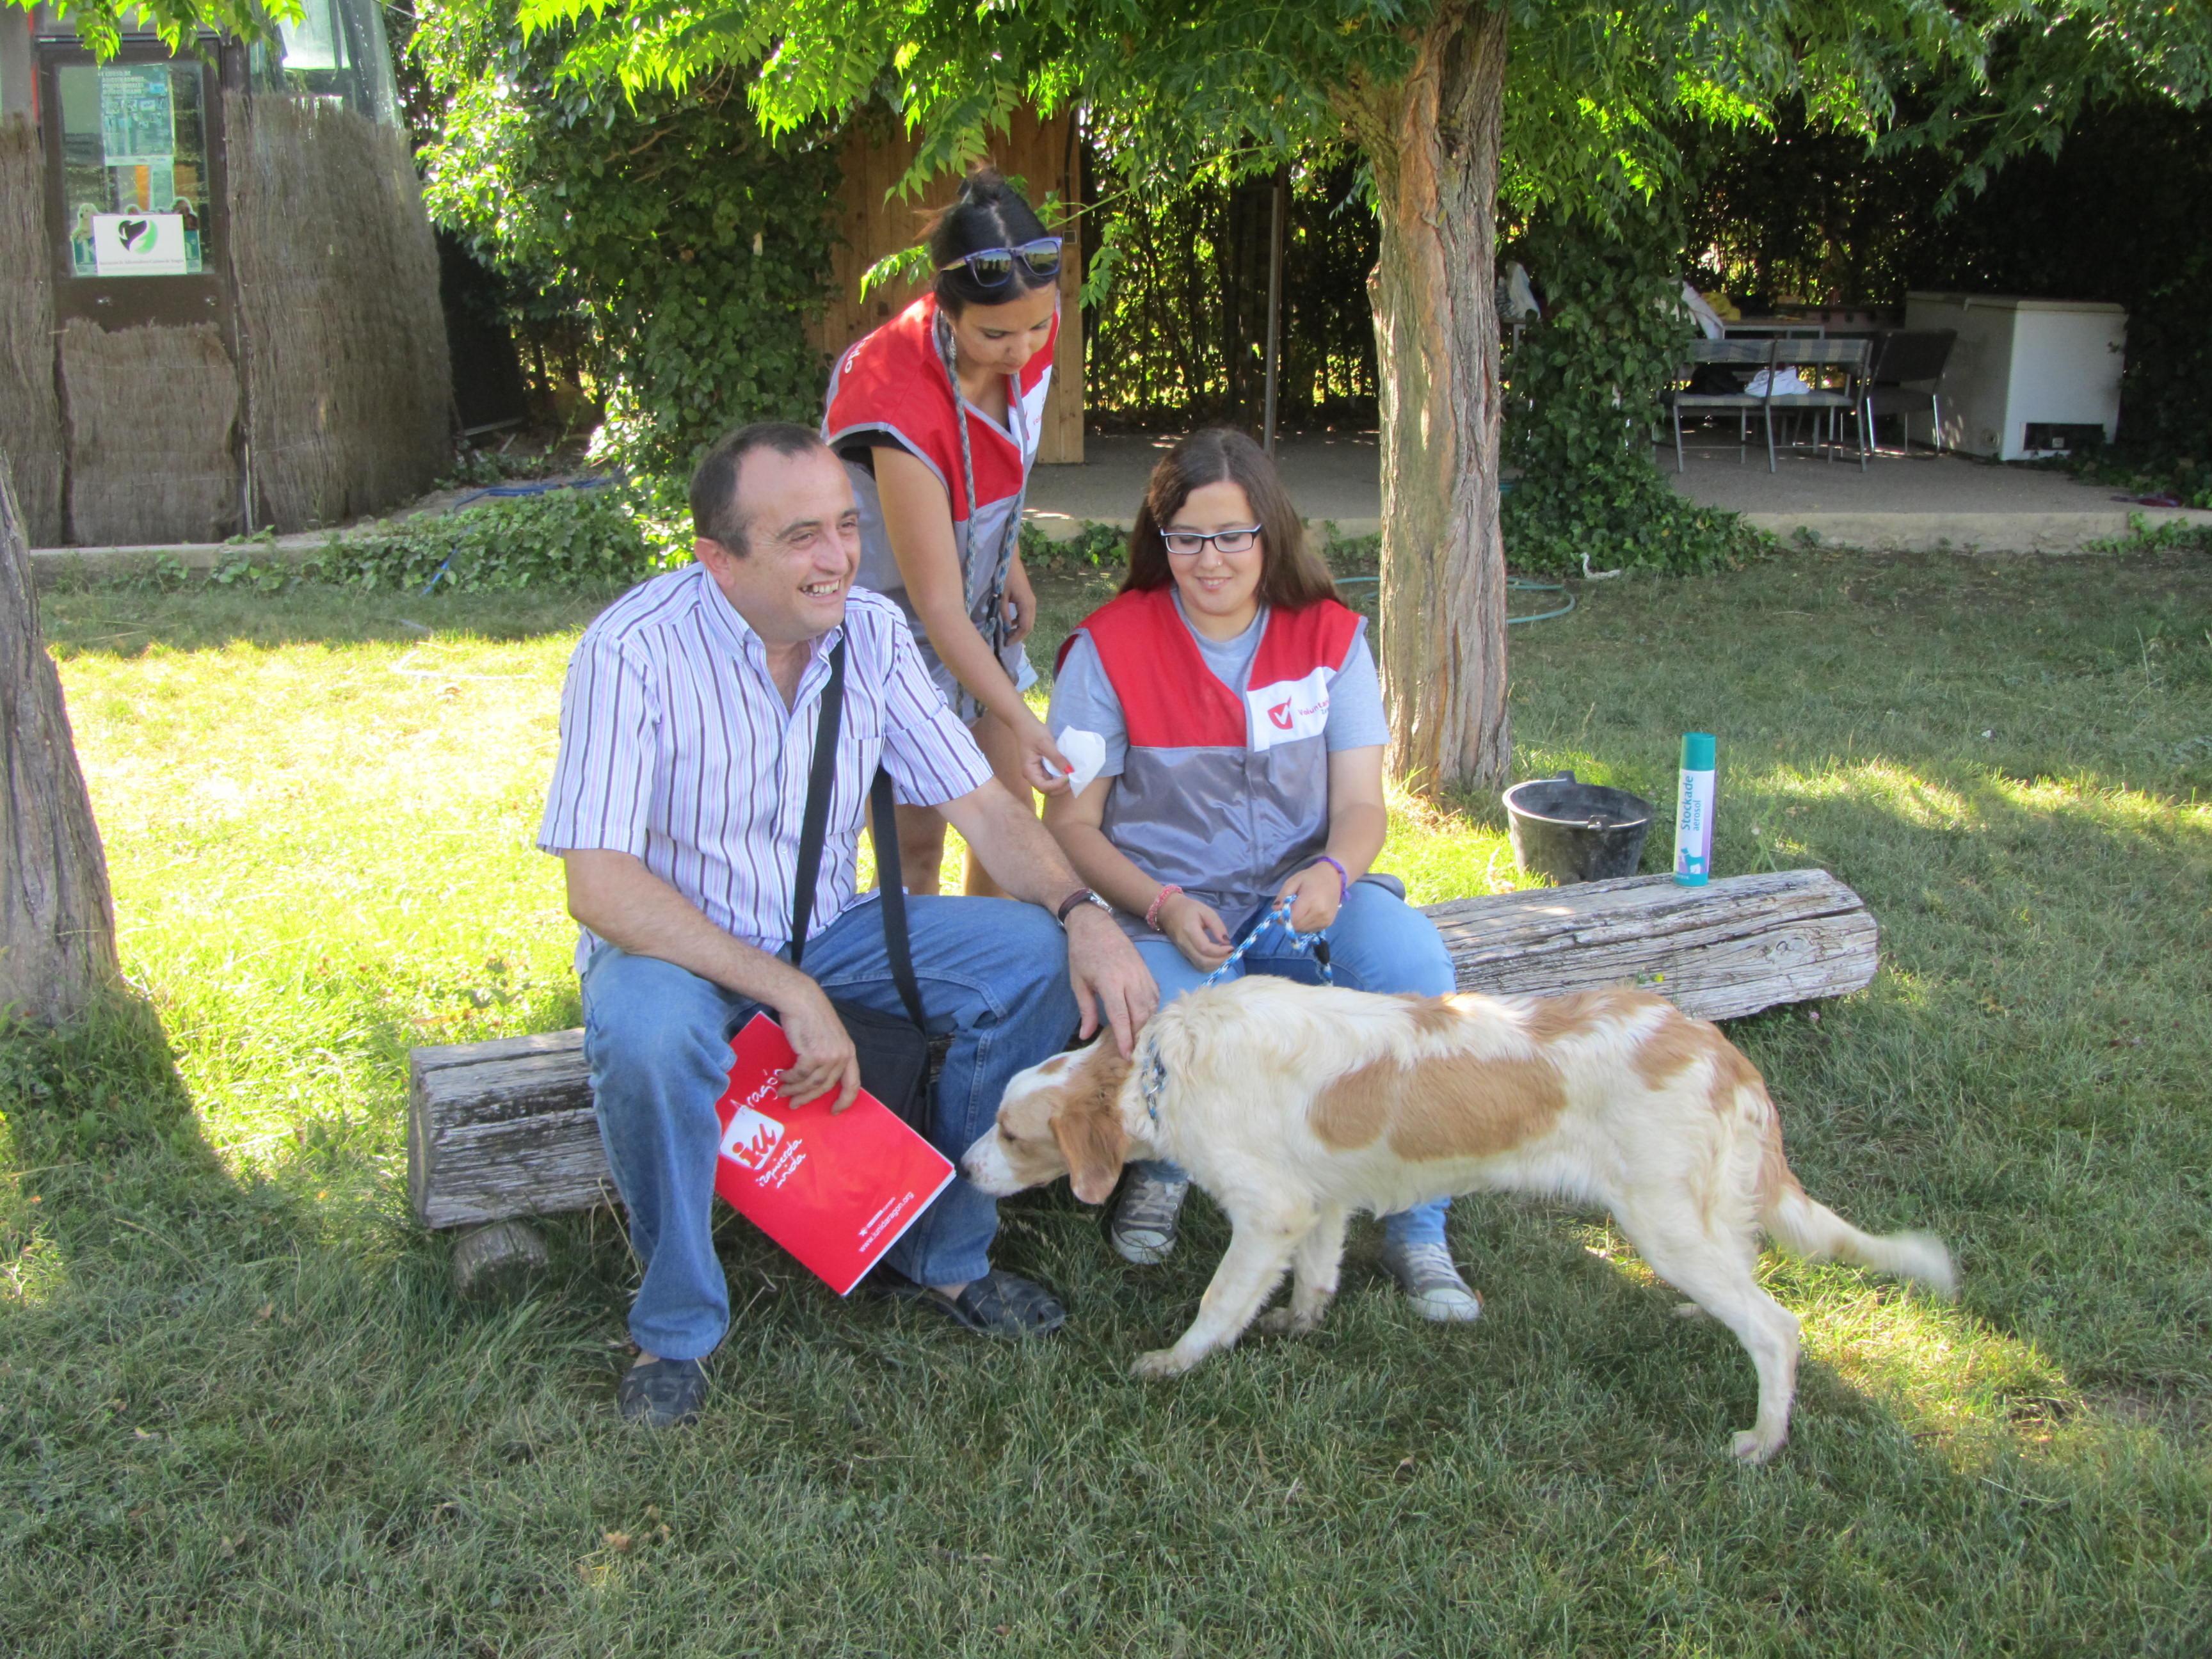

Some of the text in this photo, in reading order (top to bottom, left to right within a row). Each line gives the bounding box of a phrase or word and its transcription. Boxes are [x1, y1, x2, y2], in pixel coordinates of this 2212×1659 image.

[1681, 775, 1694, 831] Stockade
[1693, 800, 1702, 831] aerosol
[755, 1138, 803, 1187] izquierda
[776, 1153, 807, 1189] unida
